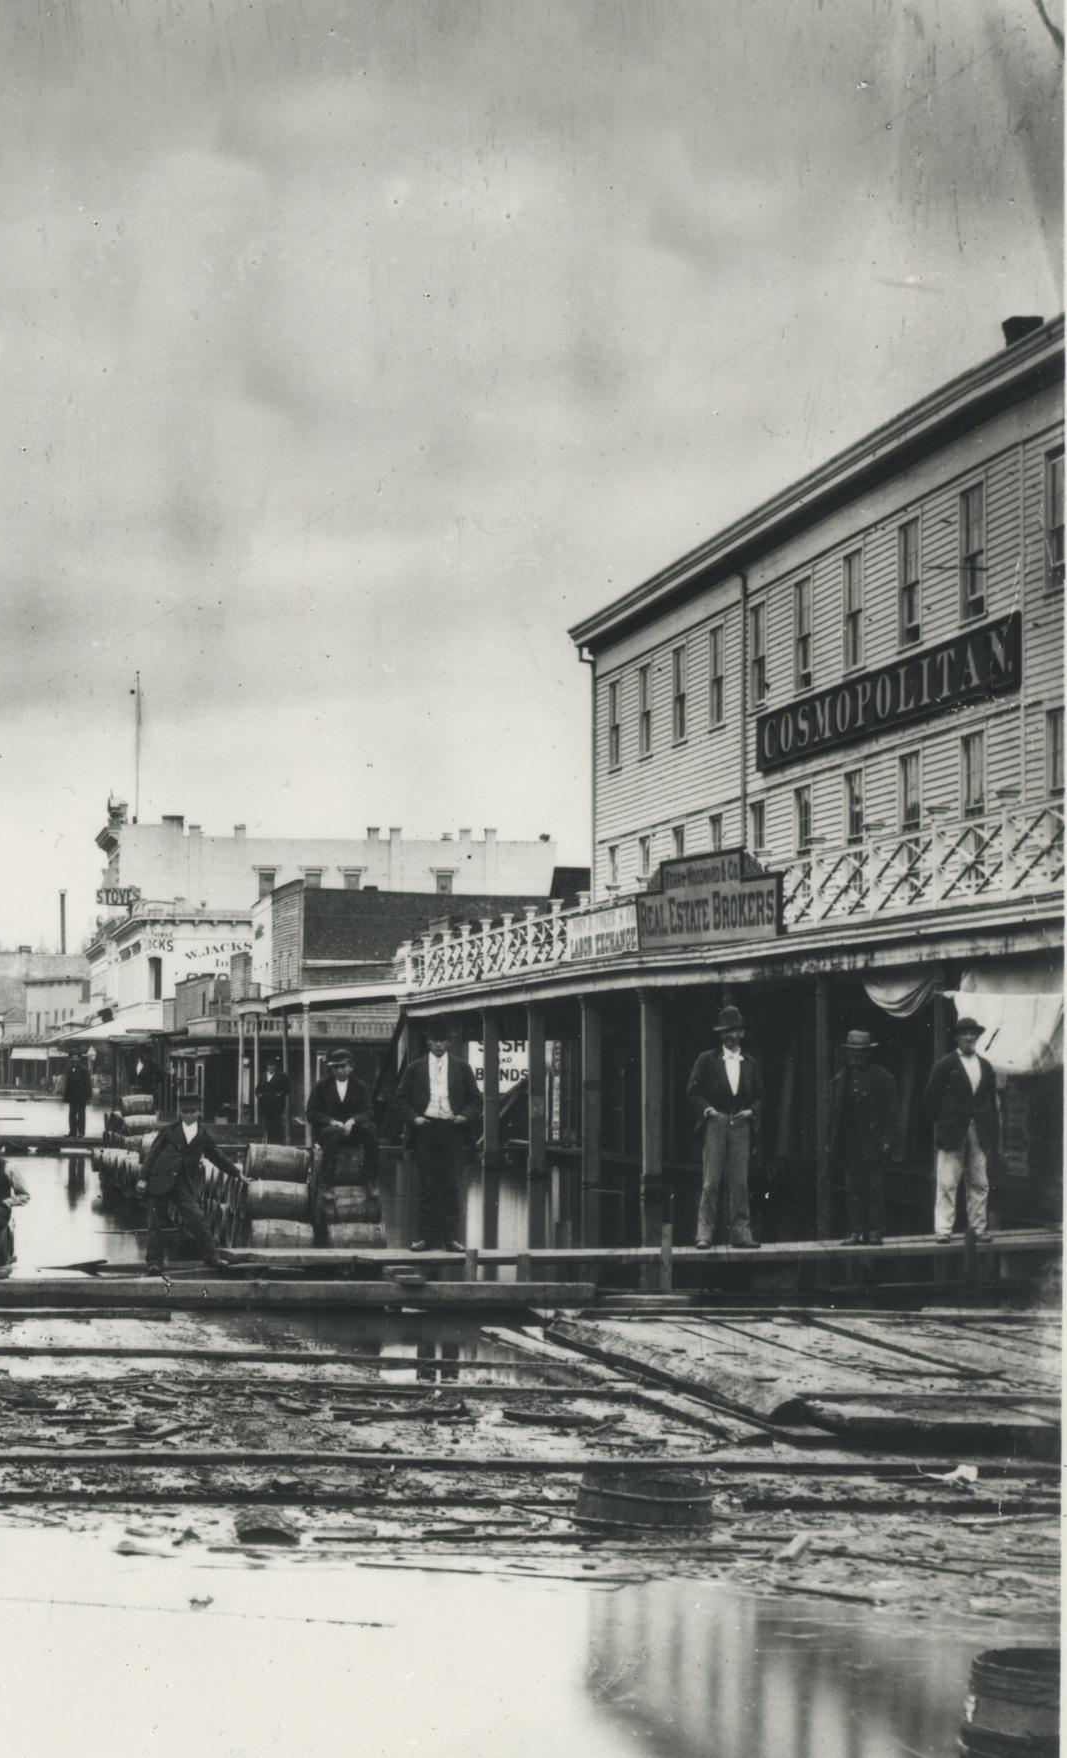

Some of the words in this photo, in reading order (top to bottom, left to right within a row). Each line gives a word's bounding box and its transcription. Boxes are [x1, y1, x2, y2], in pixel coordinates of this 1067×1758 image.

[96, 888, 141, 905] STOVES
[638, 900, 669, 937] REAL
[668, 897, 710, 934] ESTATE
[712, 889, 776, 931] BROKERS
[477, 1040, 526, 1053] SSH
[475, 1068, 531, 1082] BNDS
